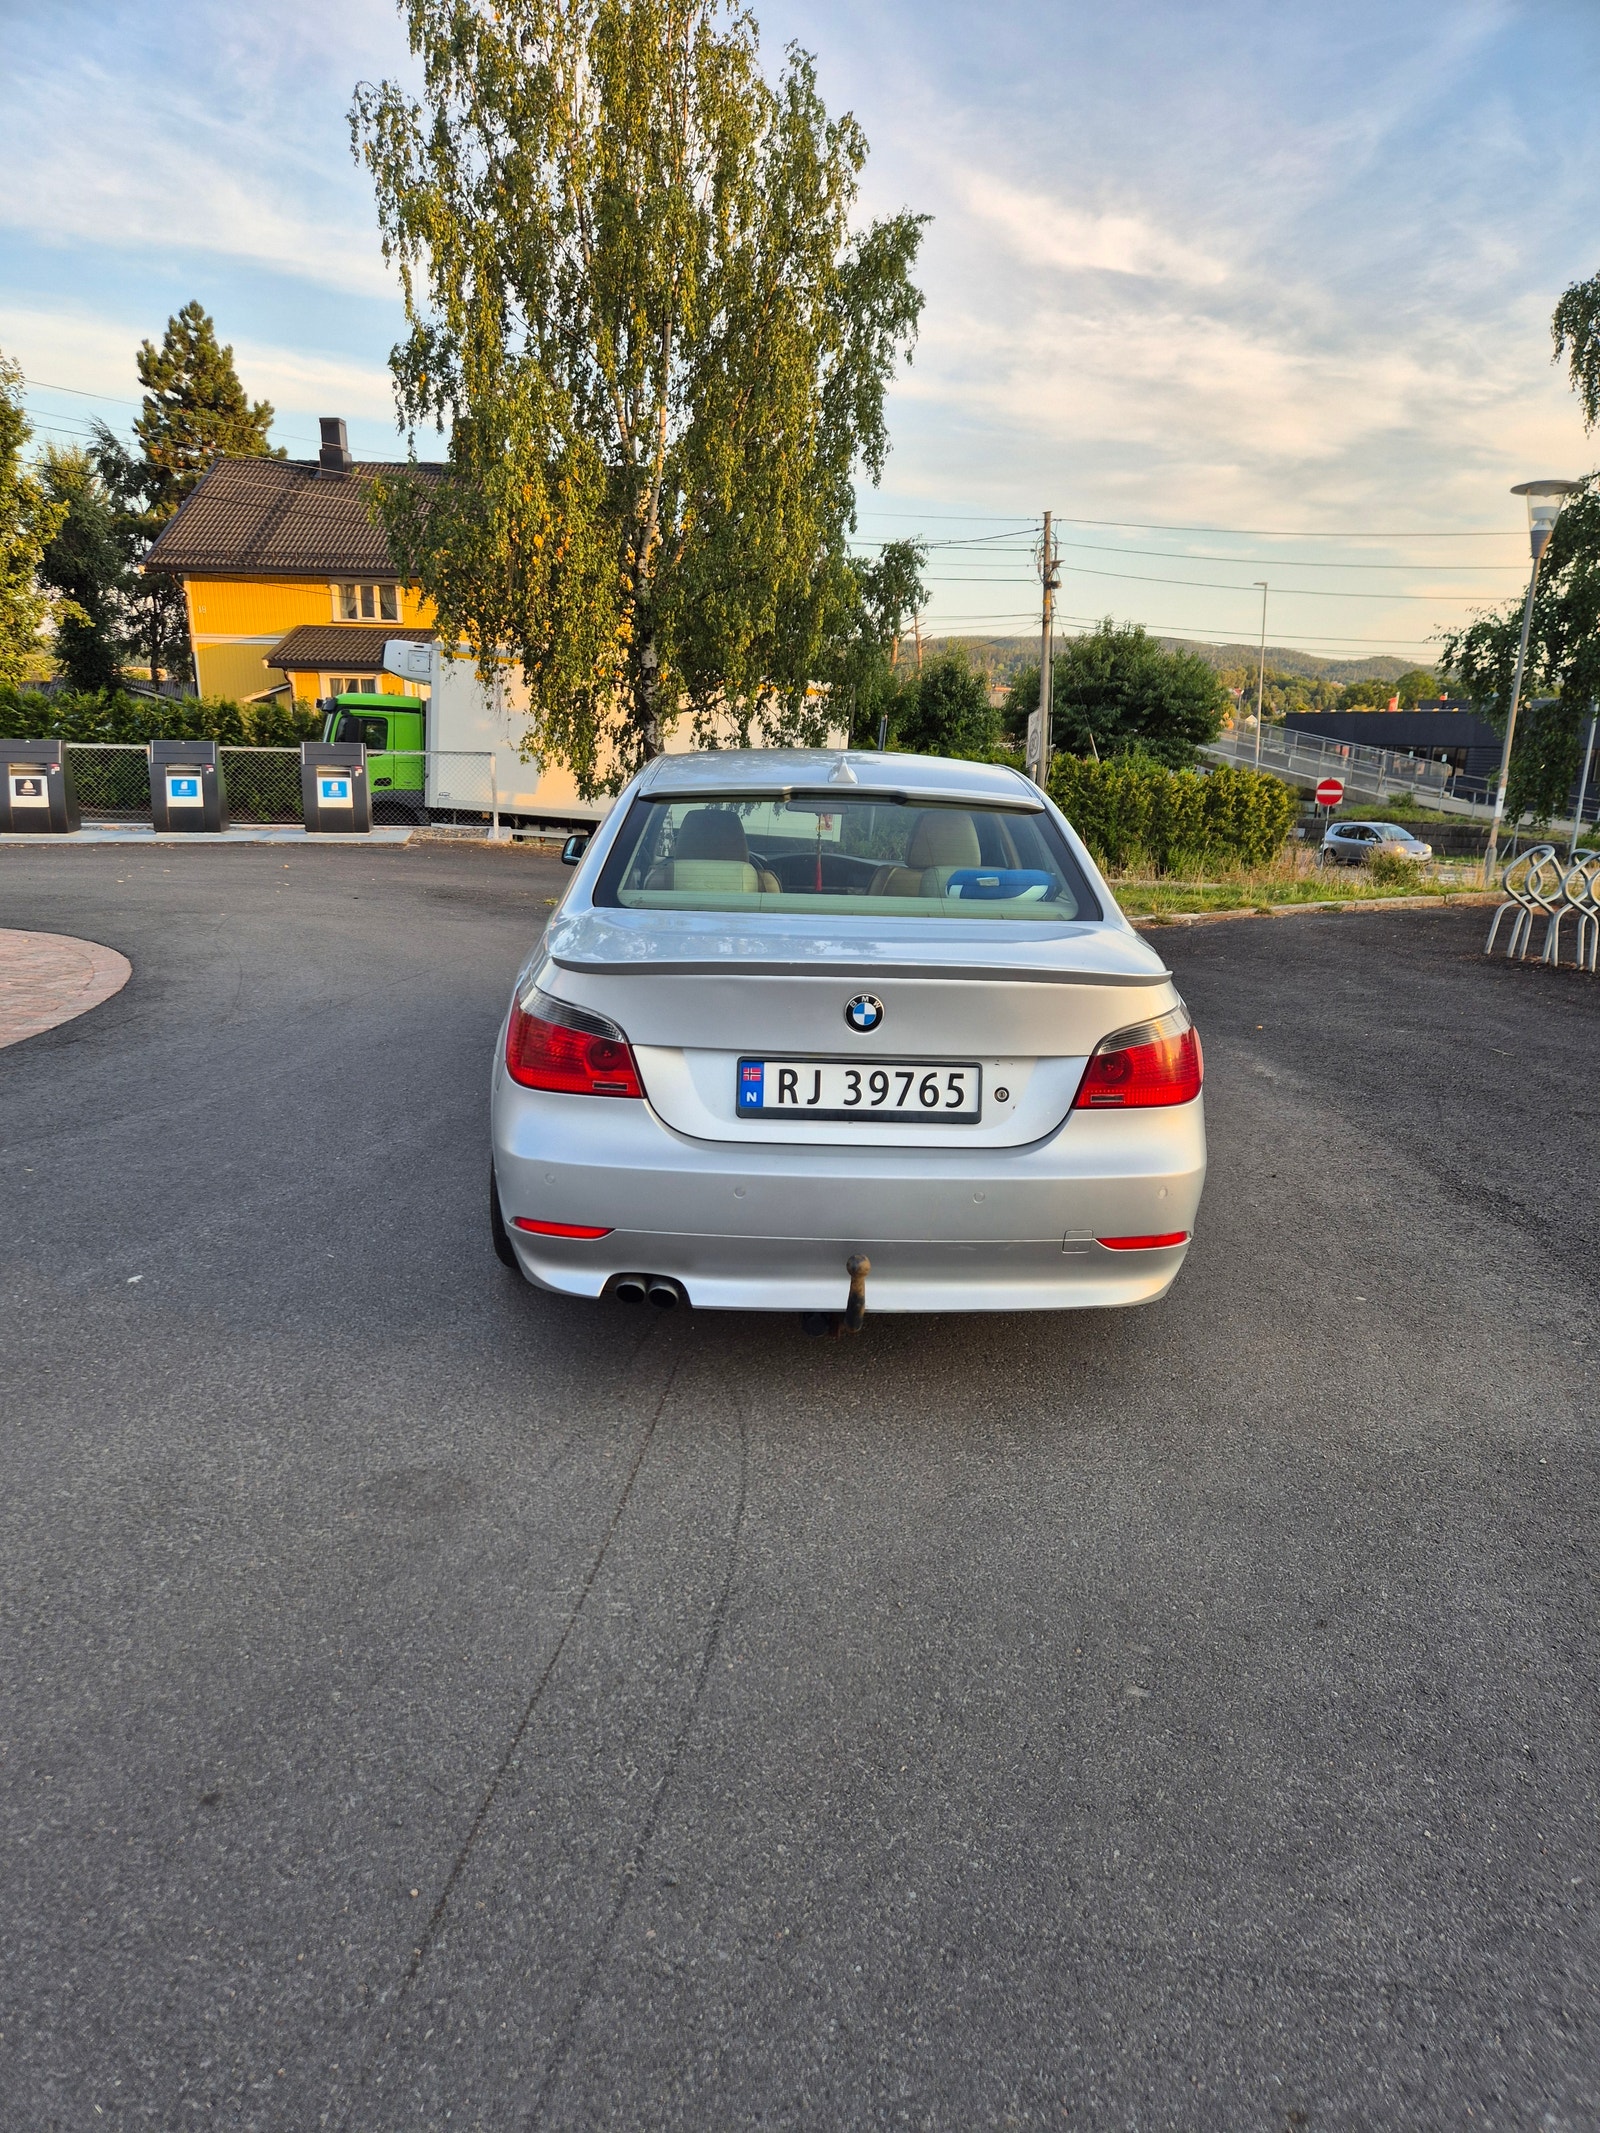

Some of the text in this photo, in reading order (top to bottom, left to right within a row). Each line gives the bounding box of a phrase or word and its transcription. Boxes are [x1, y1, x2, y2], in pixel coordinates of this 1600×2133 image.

[850, 996, 881, 1009] BMW
[778, 1068, 965, 1108] RJ 39765
[746, 1091, 757, 1103] N
